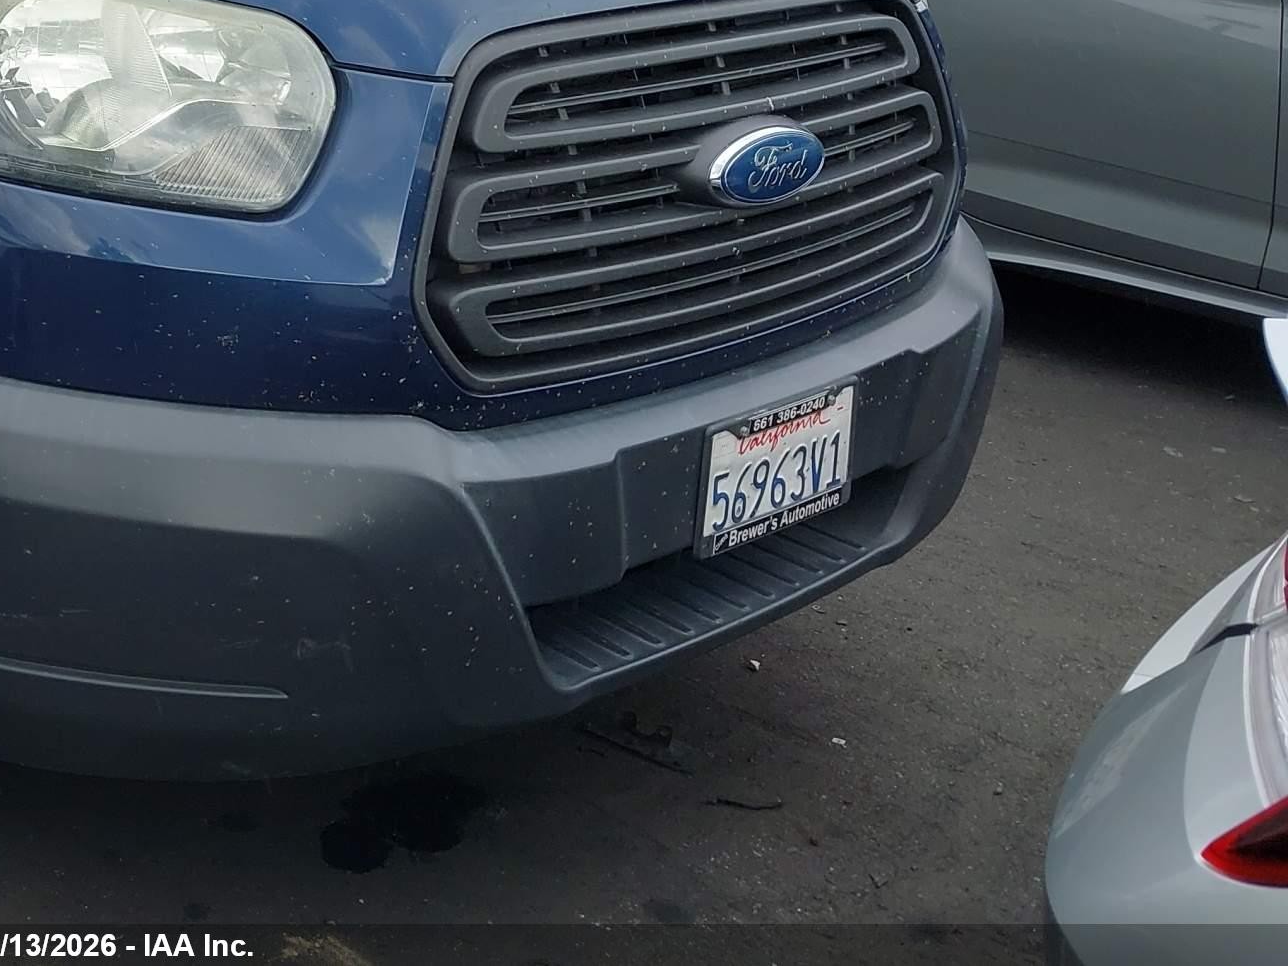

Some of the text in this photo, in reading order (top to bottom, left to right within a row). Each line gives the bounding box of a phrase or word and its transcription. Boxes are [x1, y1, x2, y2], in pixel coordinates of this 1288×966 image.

[748, 142, 808, 193] Ford
[738, 408, 830, 455] California
[753, 395, 826, 432] 661 386-0240
[712, 430, 842, 532] 56963V1
[728, 515, 778, 547] Brewer's
[779, 492, 840, 528] Automotive
